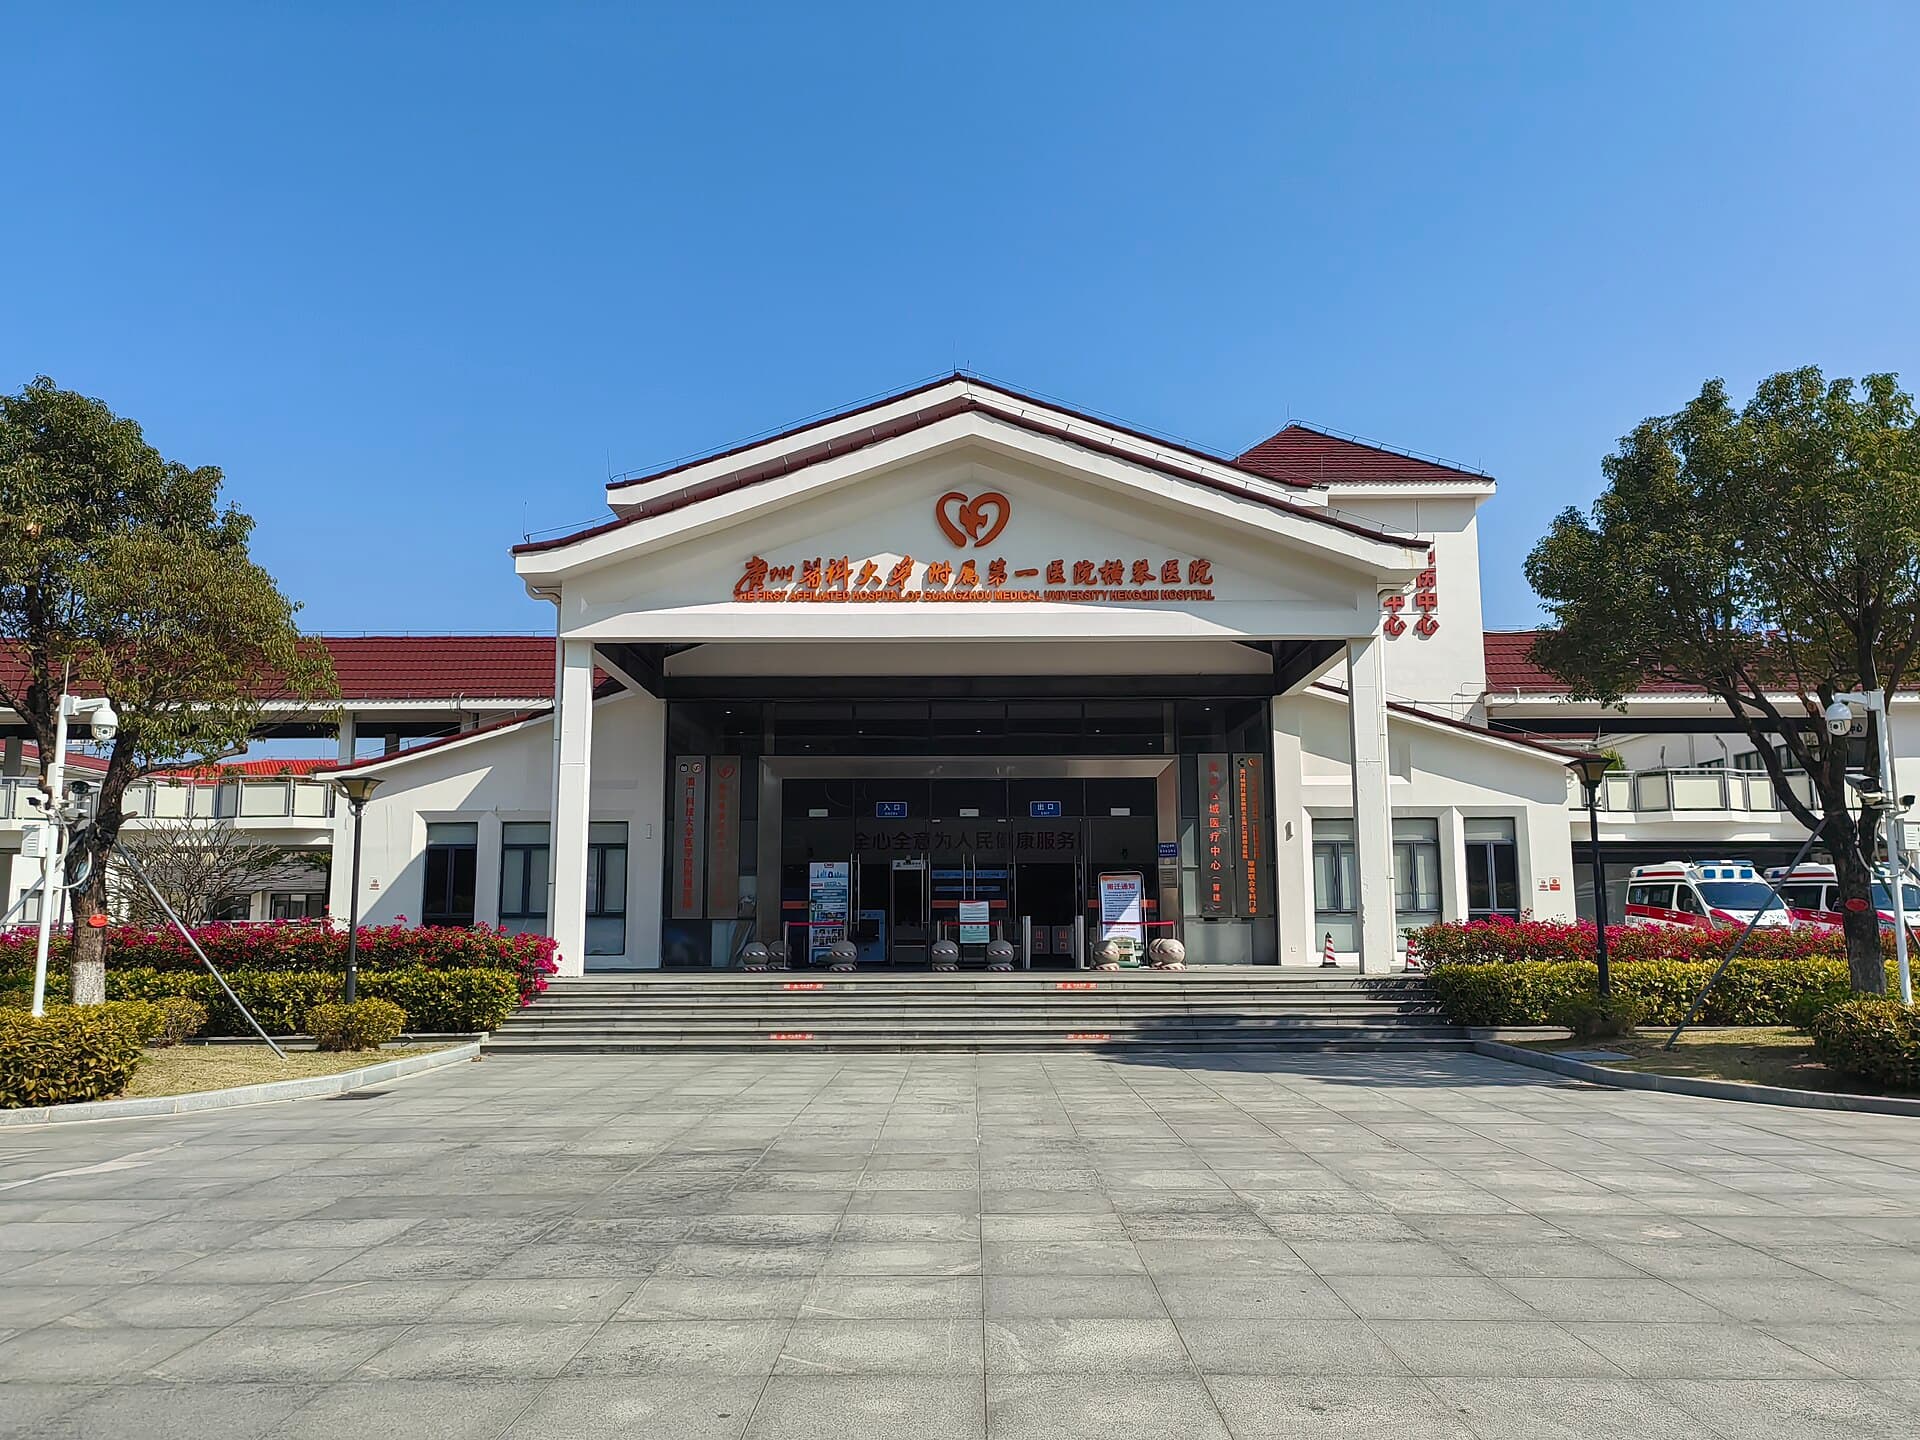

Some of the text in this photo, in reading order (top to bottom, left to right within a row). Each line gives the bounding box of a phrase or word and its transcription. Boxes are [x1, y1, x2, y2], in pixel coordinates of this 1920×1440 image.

[757, 591, 787, 601] FIRST
[790, 591, 850, 601] AFFILIATED
[852, 591, 906, 601] HOSPITAL
[907, 591, 921, 601] OF
[923, 591, 991, 601] GUANGZHOU
[995, 590, 1041, 601] MEDICAL
[1043, 590, 1109, 600] UNIVERSITY
[1110, 590, 1159, 600] HENGQIN
[1162, 590, 1215, 600] HOSPITAL
[883, 803, 900, 811] 入口
[1037, 803, 1054, 811] 出口
